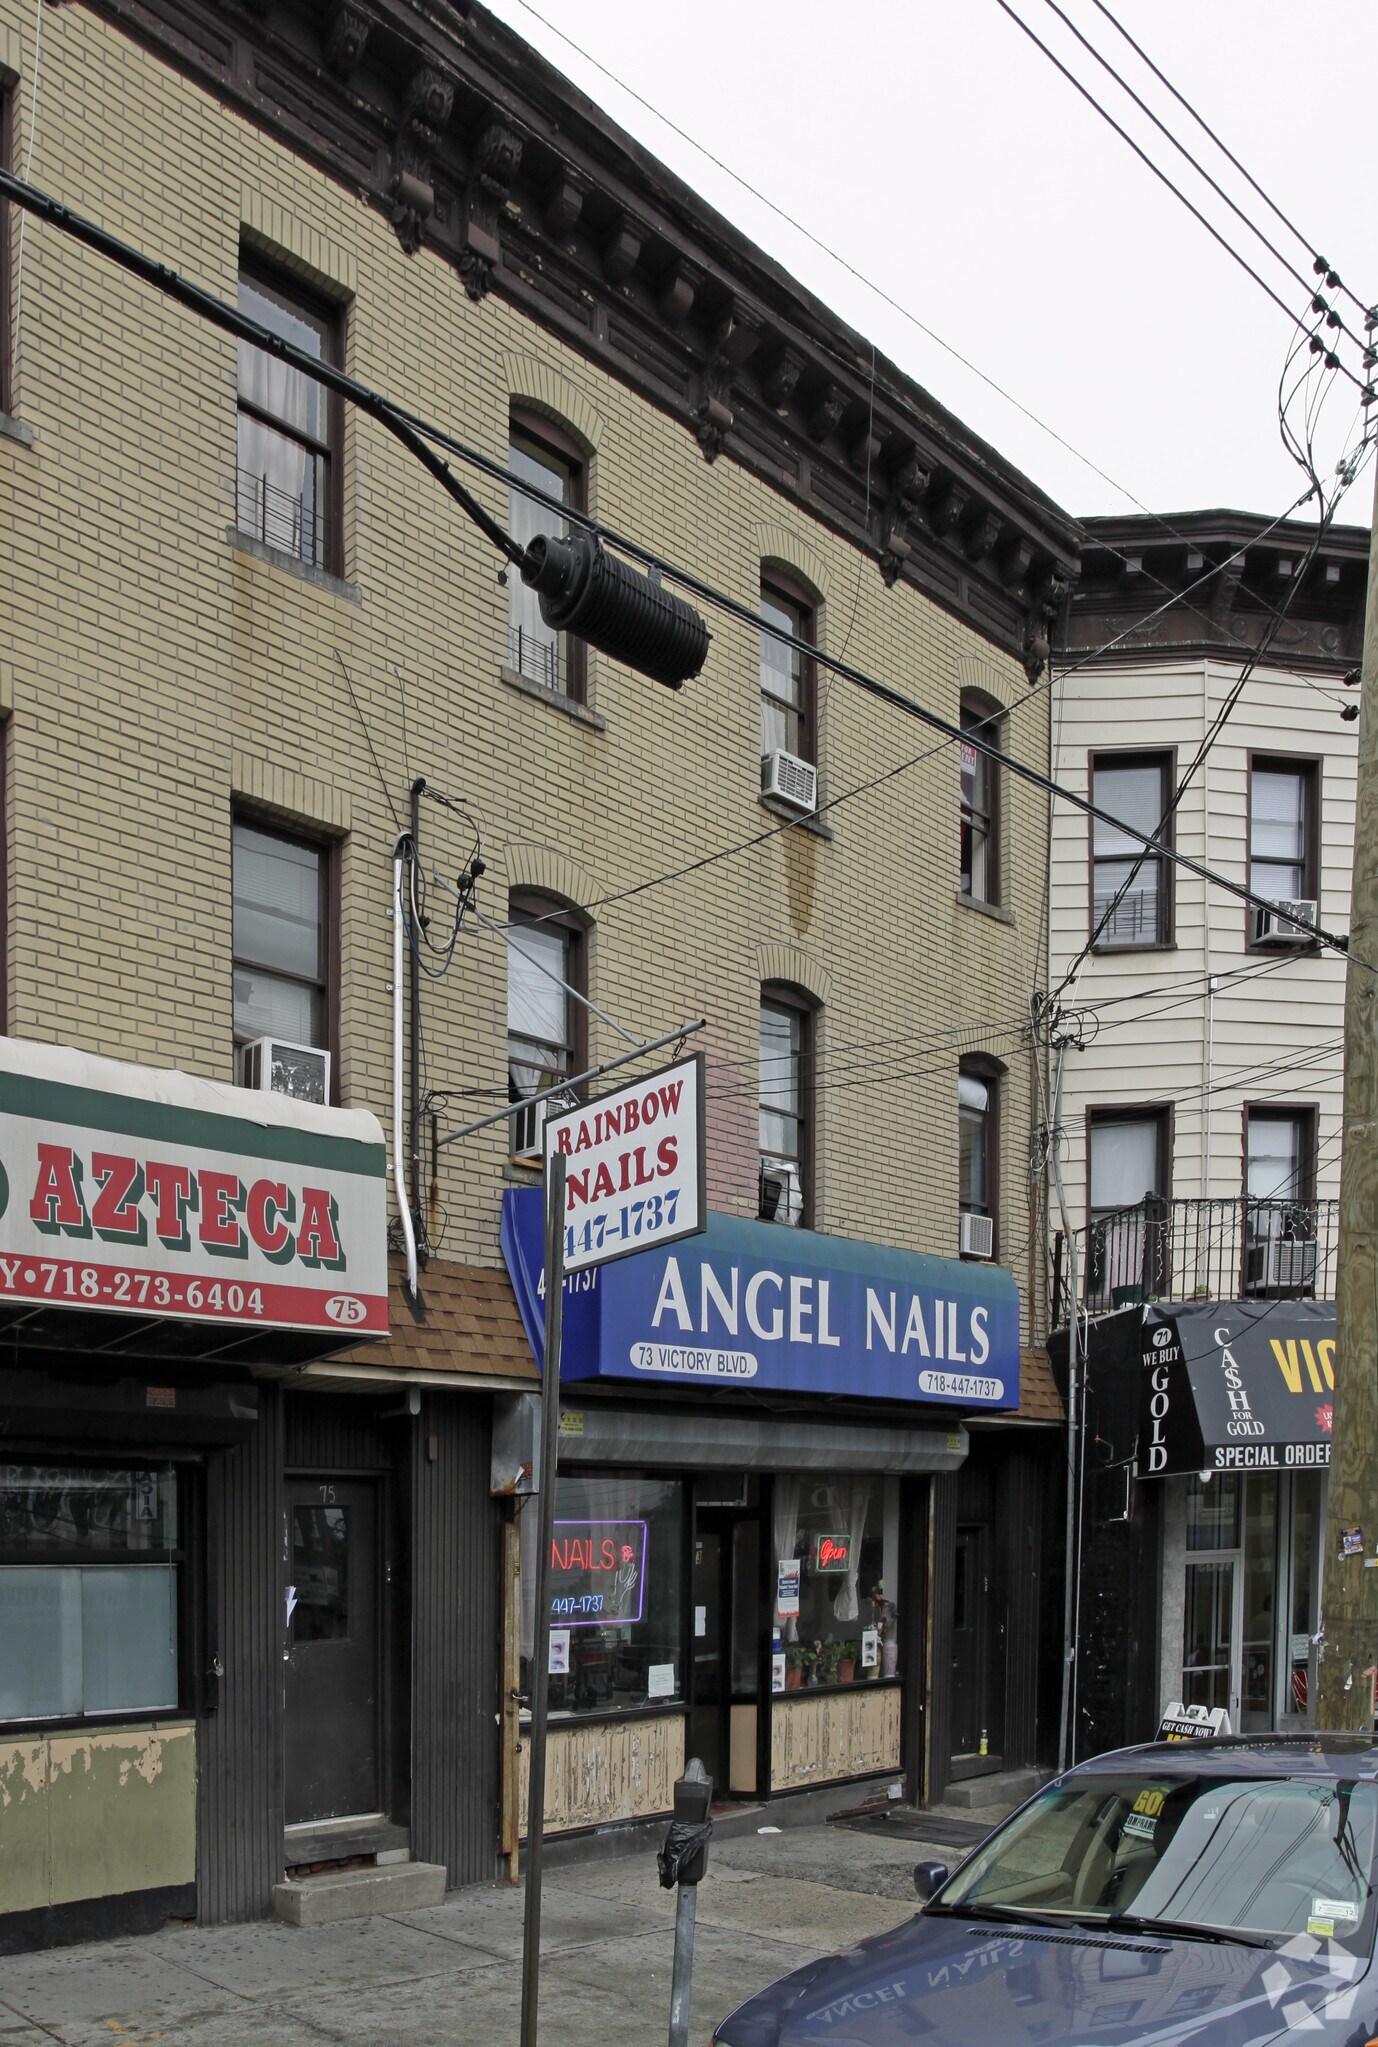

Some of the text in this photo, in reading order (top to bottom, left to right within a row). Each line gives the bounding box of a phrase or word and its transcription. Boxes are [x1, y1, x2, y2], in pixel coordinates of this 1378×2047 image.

[961, 752, 974, 766] ENT
[557, 1080, 684, 1156] RAINBOW
[566, 1135, 678, 1211] NAILS
[30, 1142, 346, 1272] AZTECA
[563, 1188, 681, 1259] 447-1737
[332, 1299, 359, 1320] 75
[651, 1256, 990, 1366] ANGEL NAILS
[1157, 1331, 1168, 1345] 71
[639, 1346, 751, 1374] 73 VICTORY BLVD.
[1143, 1346, 1181, 1367] WE BUY
[927, 1373, 997, 1398] 718-447-1737
[1148, 1366, 1170, 1472] GOLD
[1232, 1411, 1253, 1420] FOR
[1226, 1421, 1265, 1436] GOLD
[1215, 1446, 1279, 1468] SPECIAL
[319, 1484, 336, 1504] 75
[551, 1538, 615, 1571] NAILS
[1162, 1721, 1177, 1732] GET
[1176, 1723, 1195, 1735] CASH
